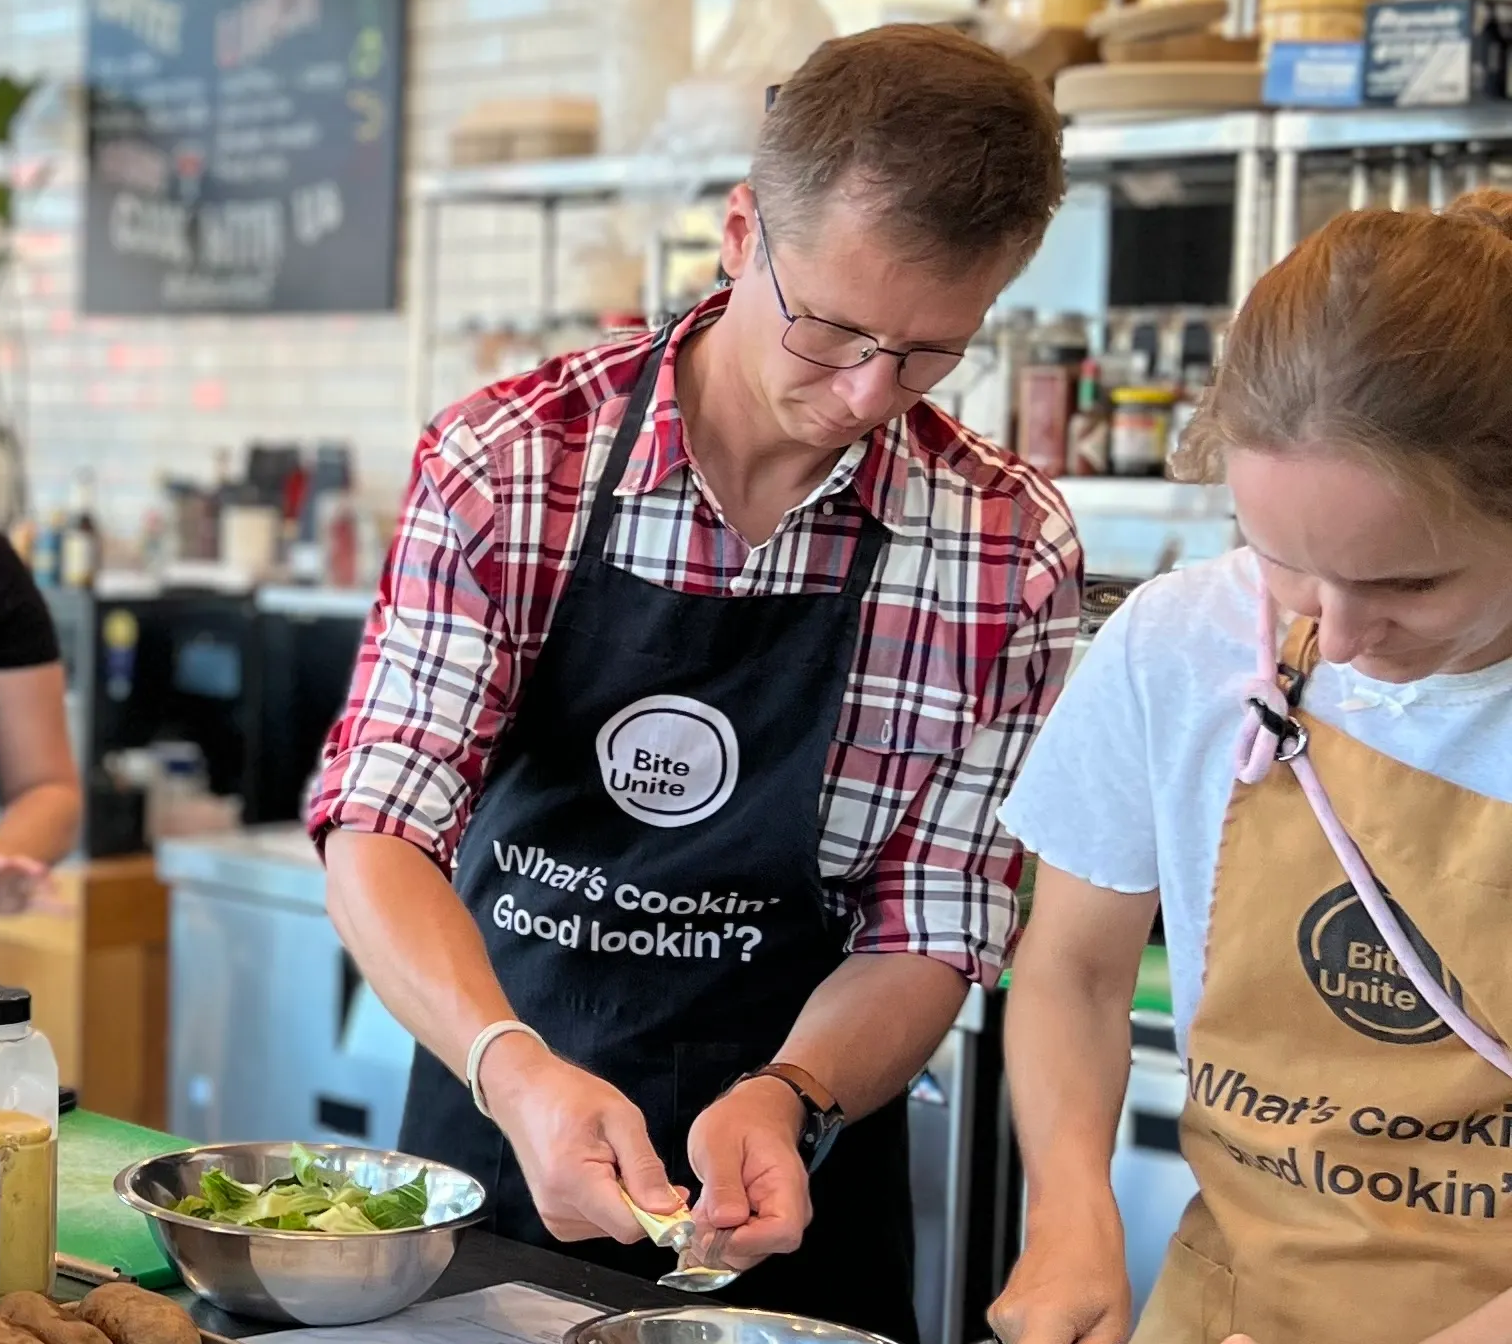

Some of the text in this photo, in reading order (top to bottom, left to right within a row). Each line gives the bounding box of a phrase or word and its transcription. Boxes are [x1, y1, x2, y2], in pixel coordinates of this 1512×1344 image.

[609, 768, 686, 797] Unite
[633, 748, 690, 777] Bite
[492, 839, 781, 915] What's cookin'
[492, 893, 763, 962] Good lookin'?
[1348, 941, 1405, 976] Bit
[1319, 968, 1417, 1011] Unite
[1187, 1057, 1340, 1125] What's
